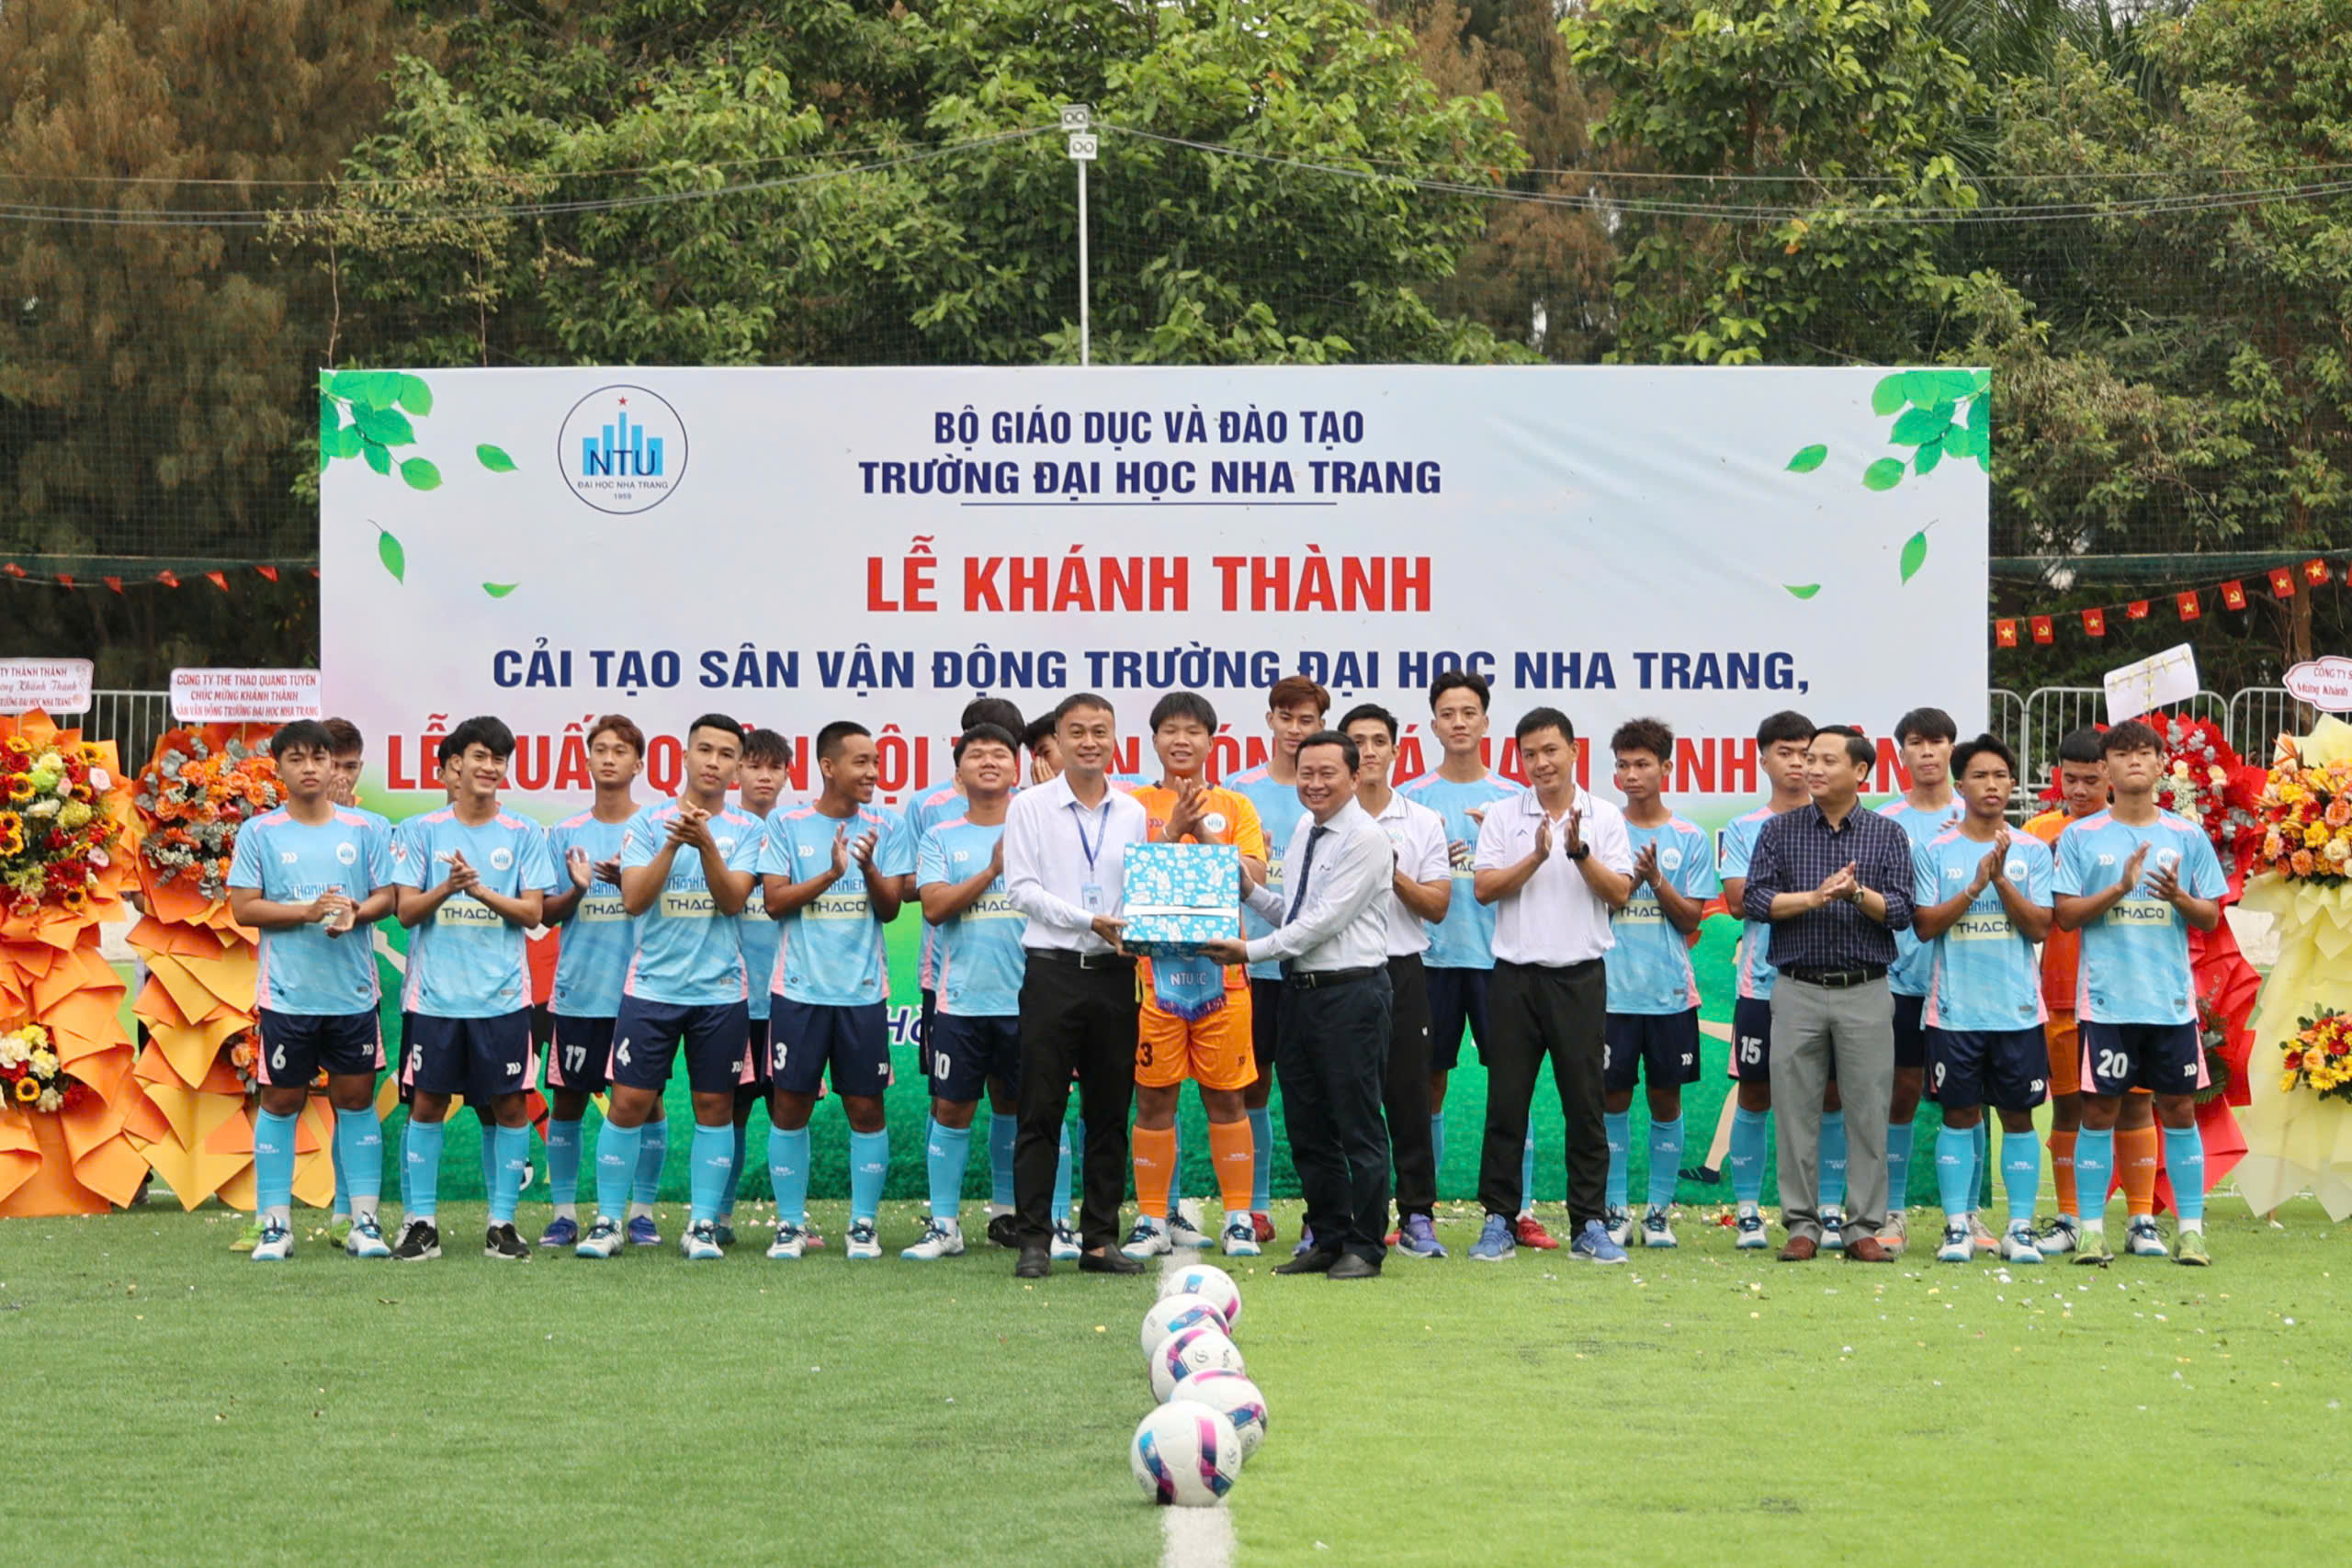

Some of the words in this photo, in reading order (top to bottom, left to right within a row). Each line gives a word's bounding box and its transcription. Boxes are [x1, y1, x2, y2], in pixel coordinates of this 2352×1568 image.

[934, 404, 978, 451] BỘ
[992, 404, 1071, 444] GIÁO
[1084, 411, 1151, 451] DỤC
[1164, 403, 1207, 443] VÀ
[1218, 404, 1287, 444] ĐÀO
[1299, 411, 1363, 451] TẠO
[590, 449, 656, 477] NTU
[616, 480, 636, 489] NHA
[638, 480, 669, 489] TRANG
[858, 453, 1019, 494] TRƯỜNG
[1033, 461, 1100, 502] ĐẠI
[1116, 461, 1195, 502] HỌC
[1211, 461, 1295, 493] NHA
[1308, 461, 1441, 494] TRANG
[868, 535, 938, 612] LỄ
[964, 545, 1189, 612] KHÁNH
[1212, 544, 1430, 612] THÀNH
[203, 674, 214, 685] TY
[493, 637, 571, 688] CẢI
[589, 650, 680, 696] TẠO
[699, 642, 798, 688] SÂN
[817, 643, 914, 697] VẬN
[931, 642, 1067, 697] ĐỘNG
[1084, 642, 1280, 689] TRƯỜNG
[1297, 650, 1379, 697] ĐẠI
[1514, 651, 1616, 689] NHA
[1633, 651, 1809, 694] TRANG,
[584, 903, 626, 916] THAC
[667, 898, 715, 911] THAC
[1620, 906, 1665, 919] THAC
[2112, 906, 2165, 919] THACO
[1956, 920, 2012, 934] THACO
[272, 1044, 287, 1070] 6
[564, 1044, 587, 1073] 17
[616, 1038, 632, 1067] 4
[1740, 1036, 1763, 1066] 15
[2097, 1049, 2129, 1079] 20
[1934, 1062, 1947, 1089] 9
